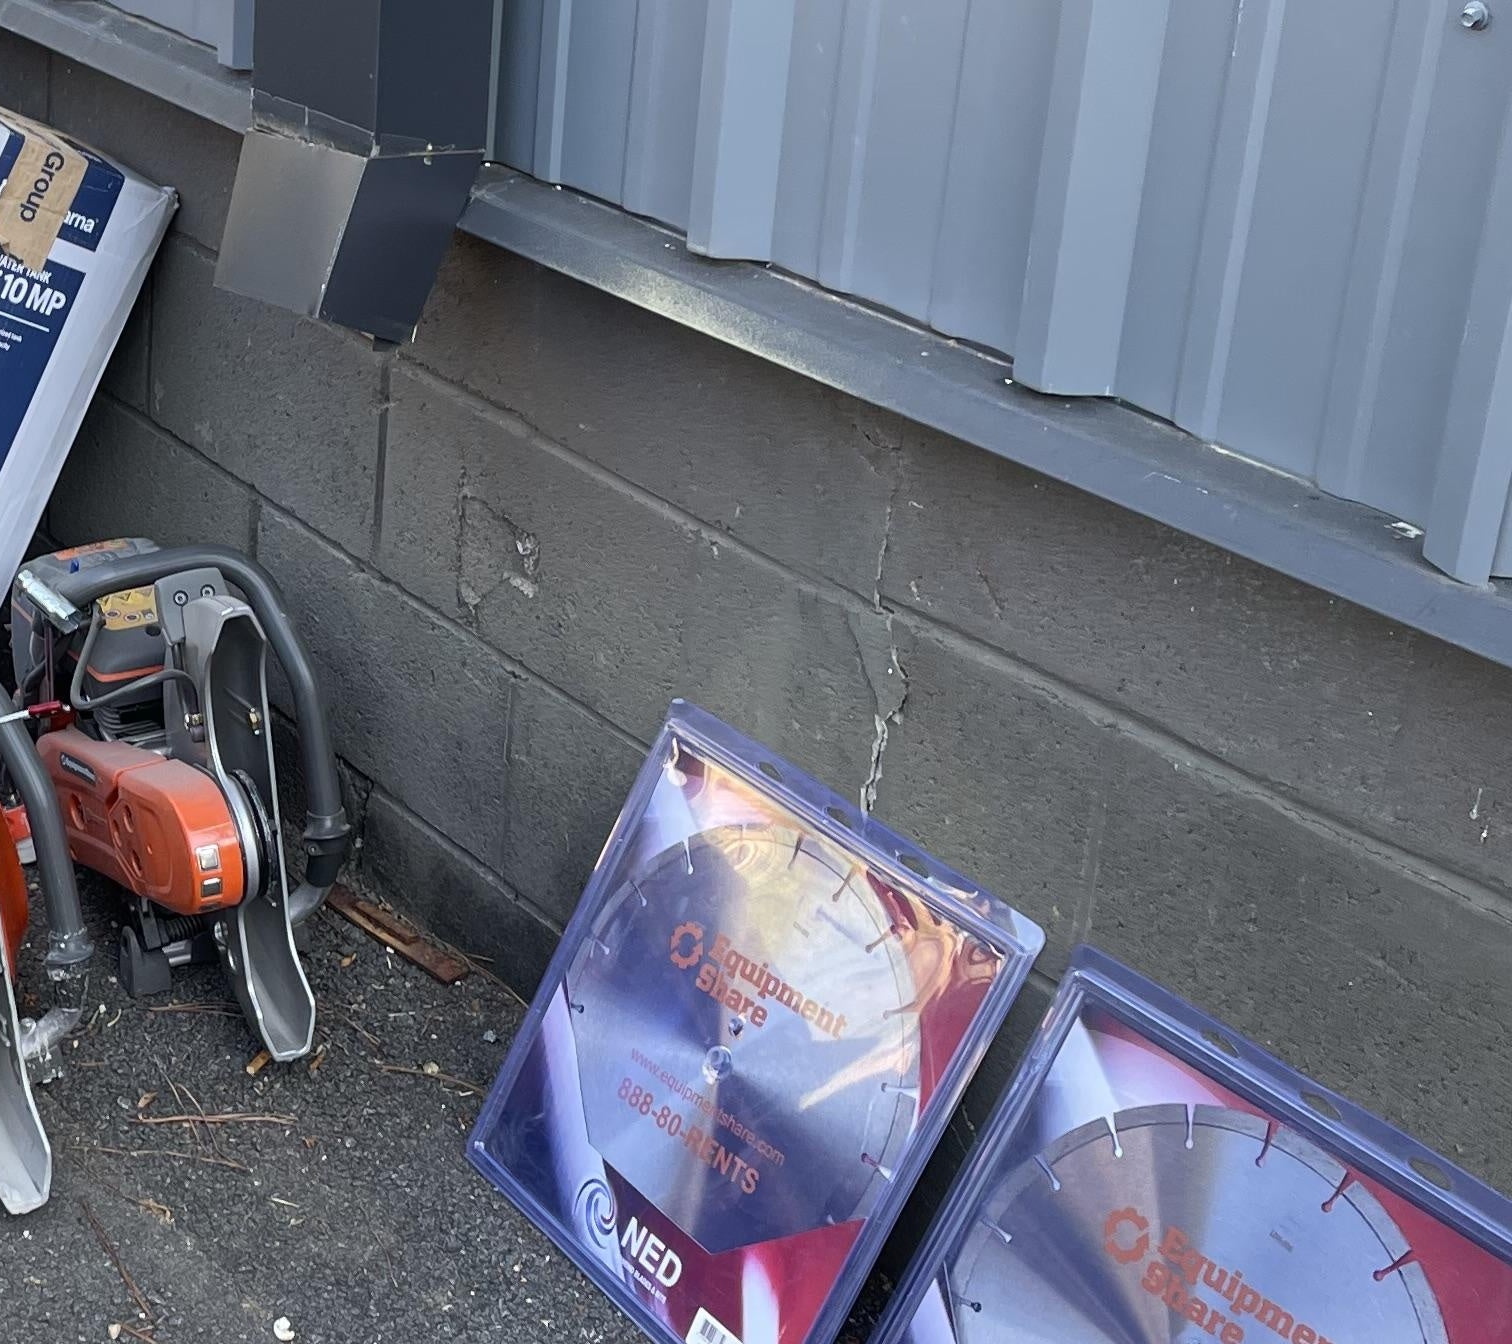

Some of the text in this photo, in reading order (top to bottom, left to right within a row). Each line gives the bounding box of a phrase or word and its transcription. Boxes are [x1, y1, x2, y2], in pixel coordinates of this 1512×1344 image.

[20, 151, 65, 222] Group
[0, 273, 28, 305] 10
[25, 282, 67, 316] MP
[695, 963, 768, 1028] Share
[708, 931, 848, 1039] Equipment
[617, 1077, 760, 1194] 888-80-RENTS
[620, 1216, 682, 1288] NED
